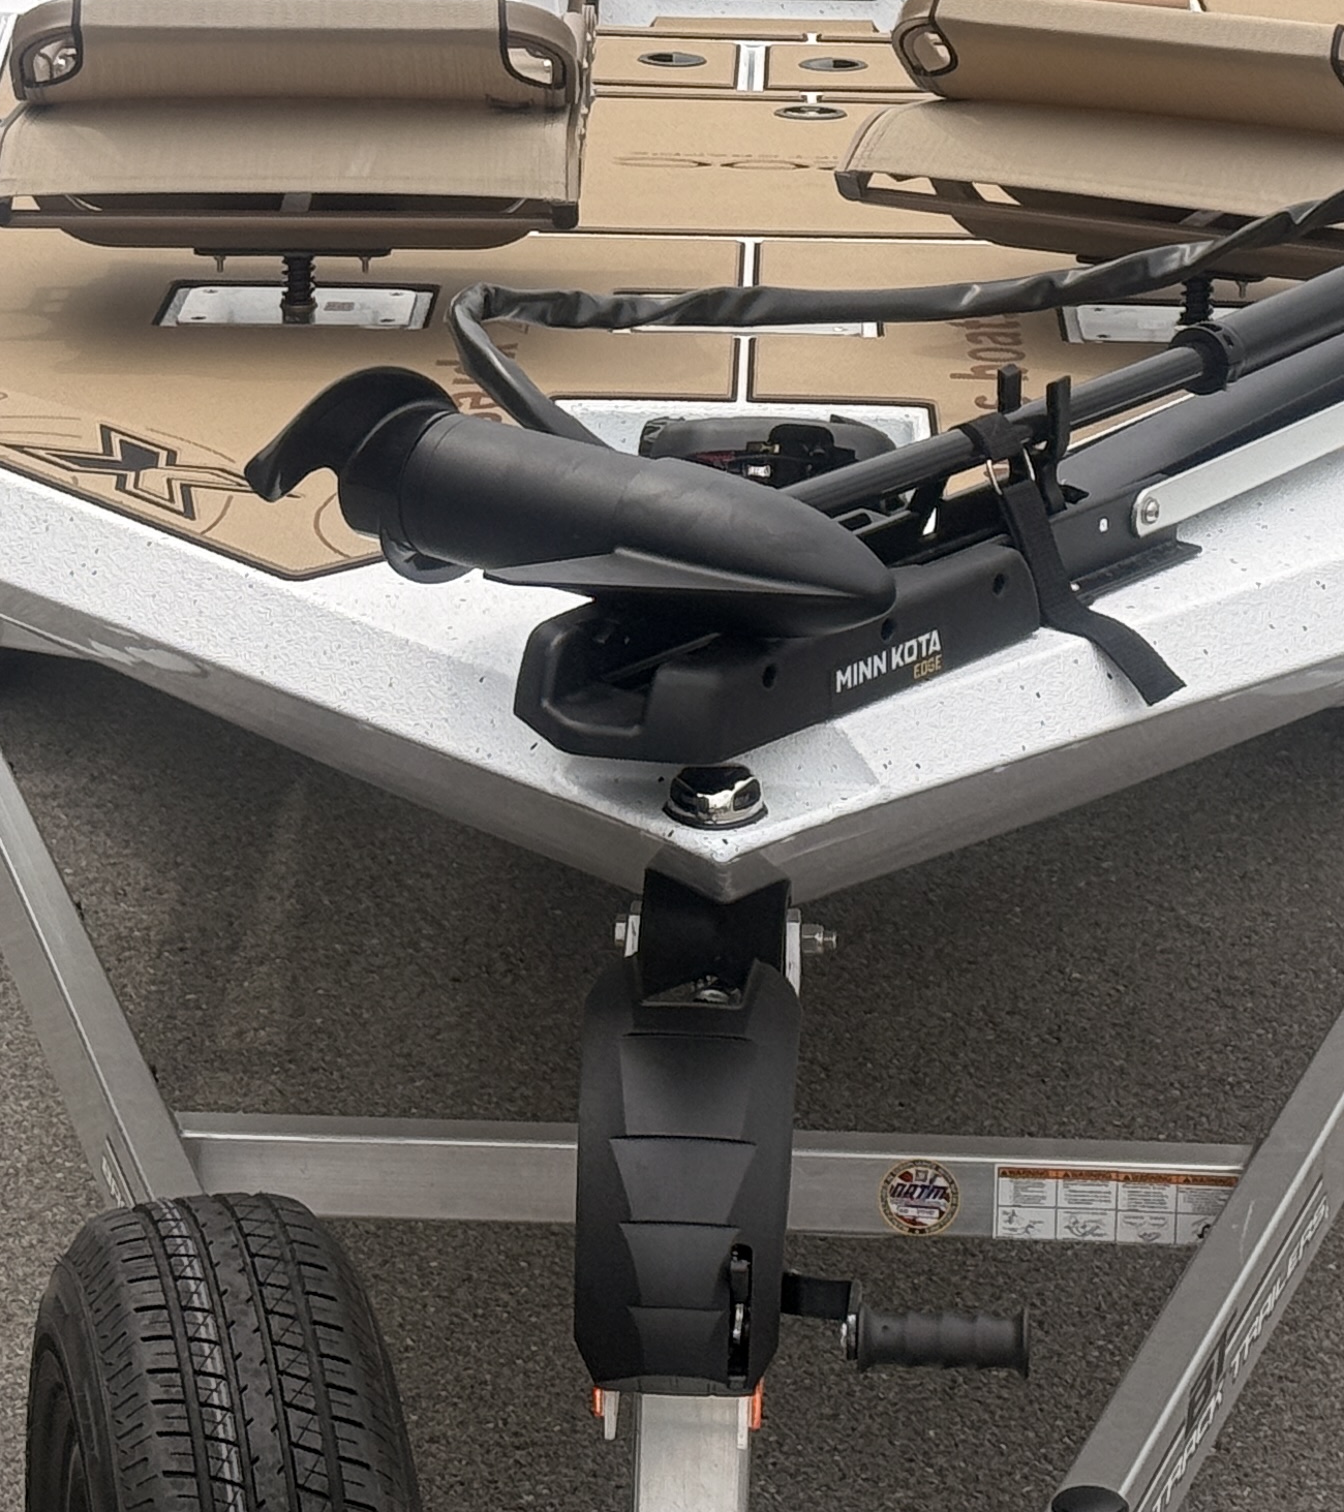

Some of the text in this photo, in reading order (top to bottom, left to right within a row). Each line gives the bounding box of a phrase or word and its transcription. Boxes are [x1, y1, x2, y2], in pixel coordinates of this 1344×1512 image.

[945, 315, 1030, 382] boat
[835, 628, 943, 694] MINN KOTA
[912, 653, 943, 680] EDGE
